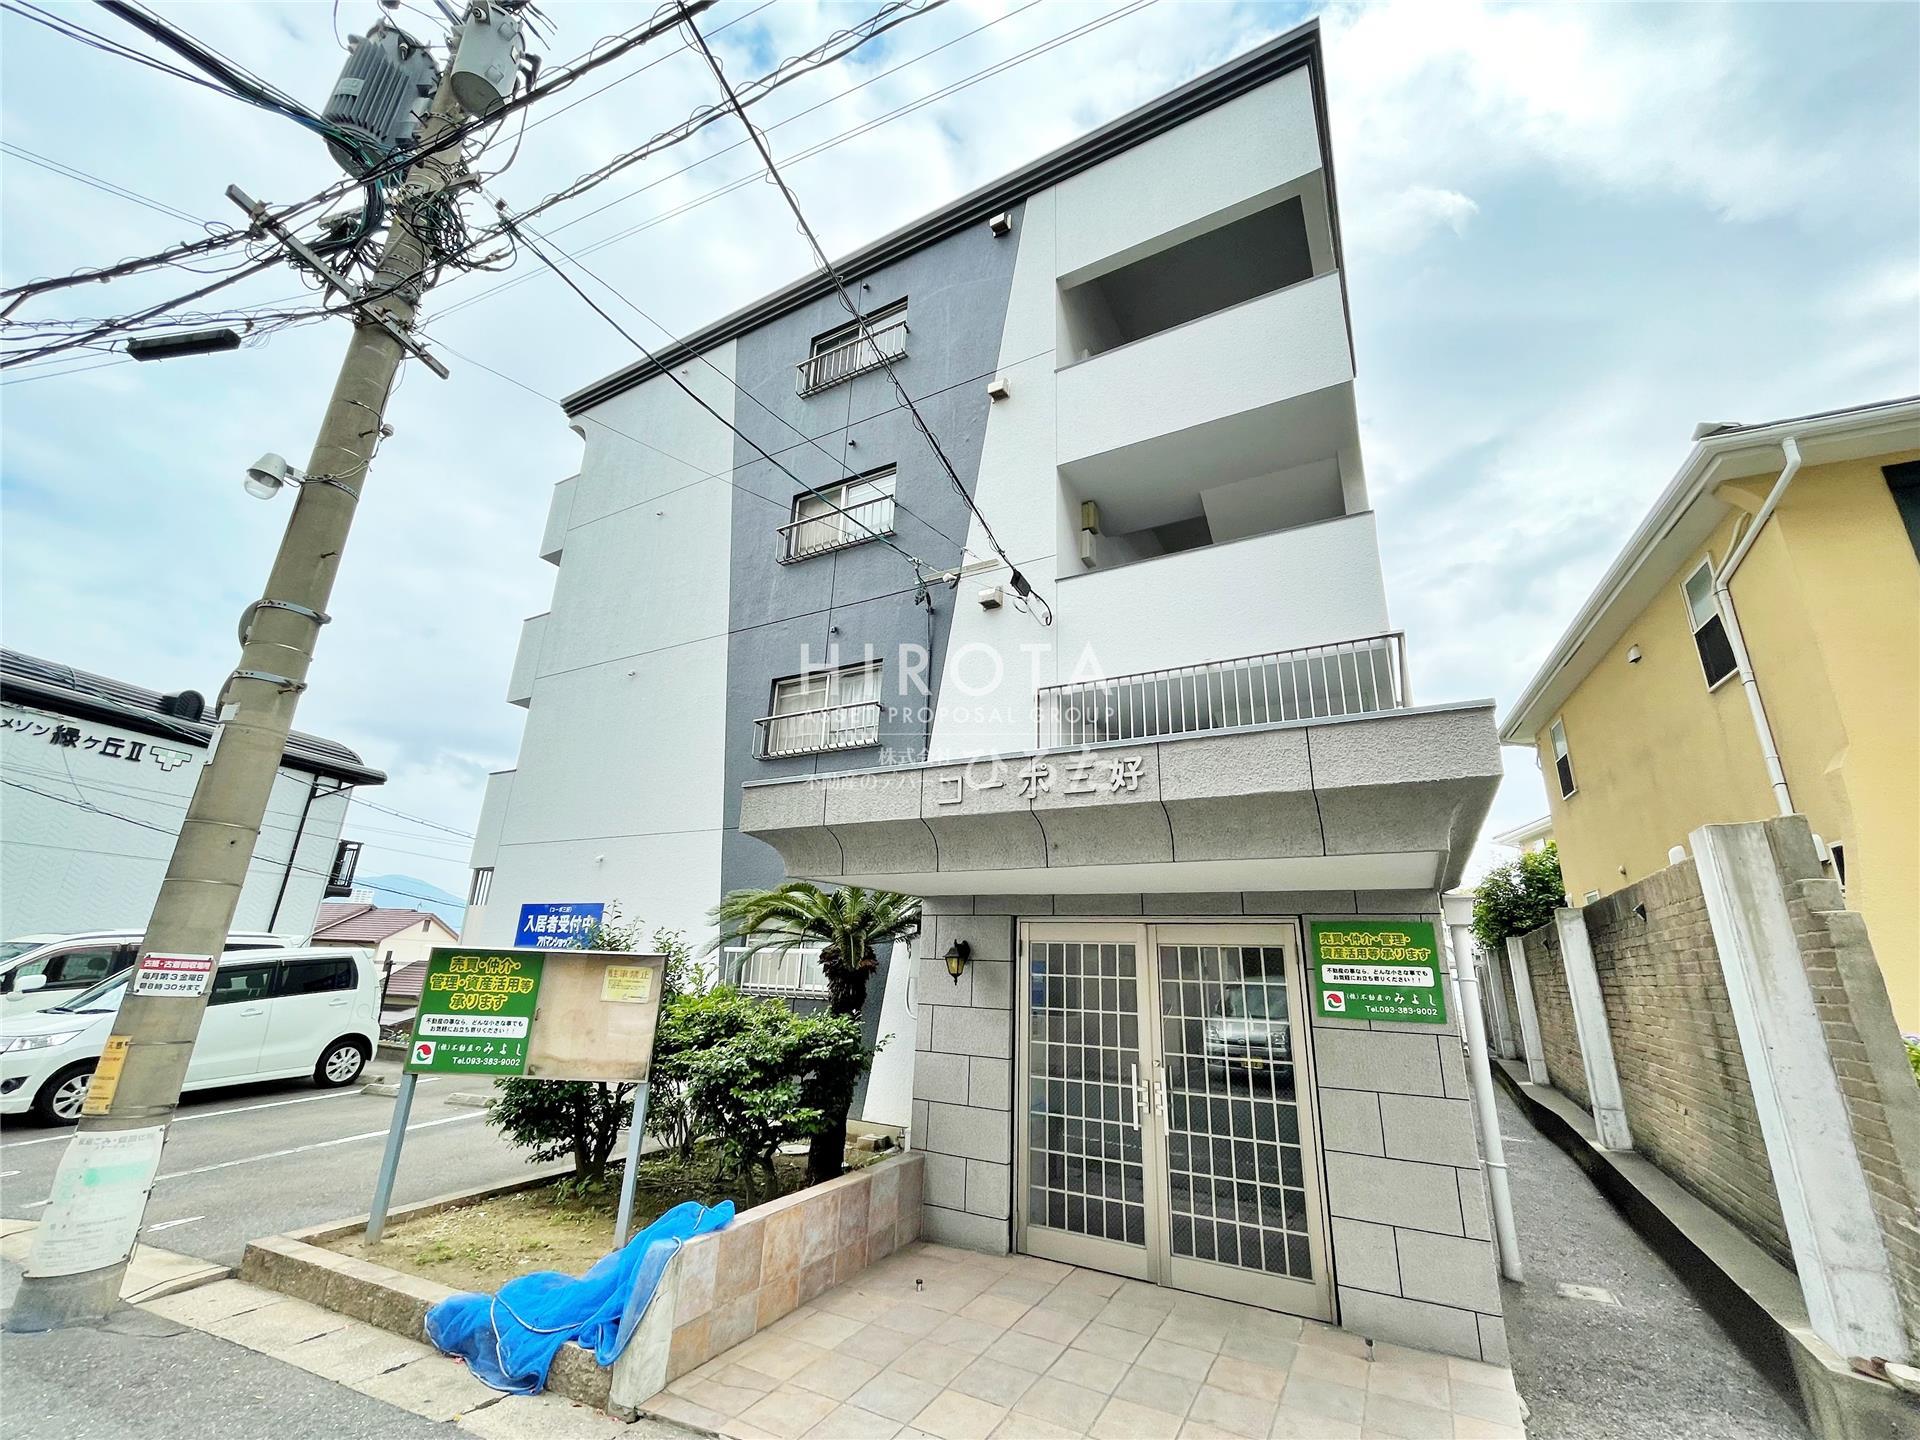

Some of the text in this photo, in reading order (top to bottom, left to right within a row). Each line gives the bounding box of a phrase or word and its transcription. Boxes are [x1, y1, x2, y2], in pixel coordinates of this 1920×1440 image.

[523, 914, 594, 934] 入居者受付中
[430, 973, 534, 994] 管理・資産活用等
[449, 993, 508, 1010] 承ります
[452, 1056, 521, 1066] Tel.093-383-9002
